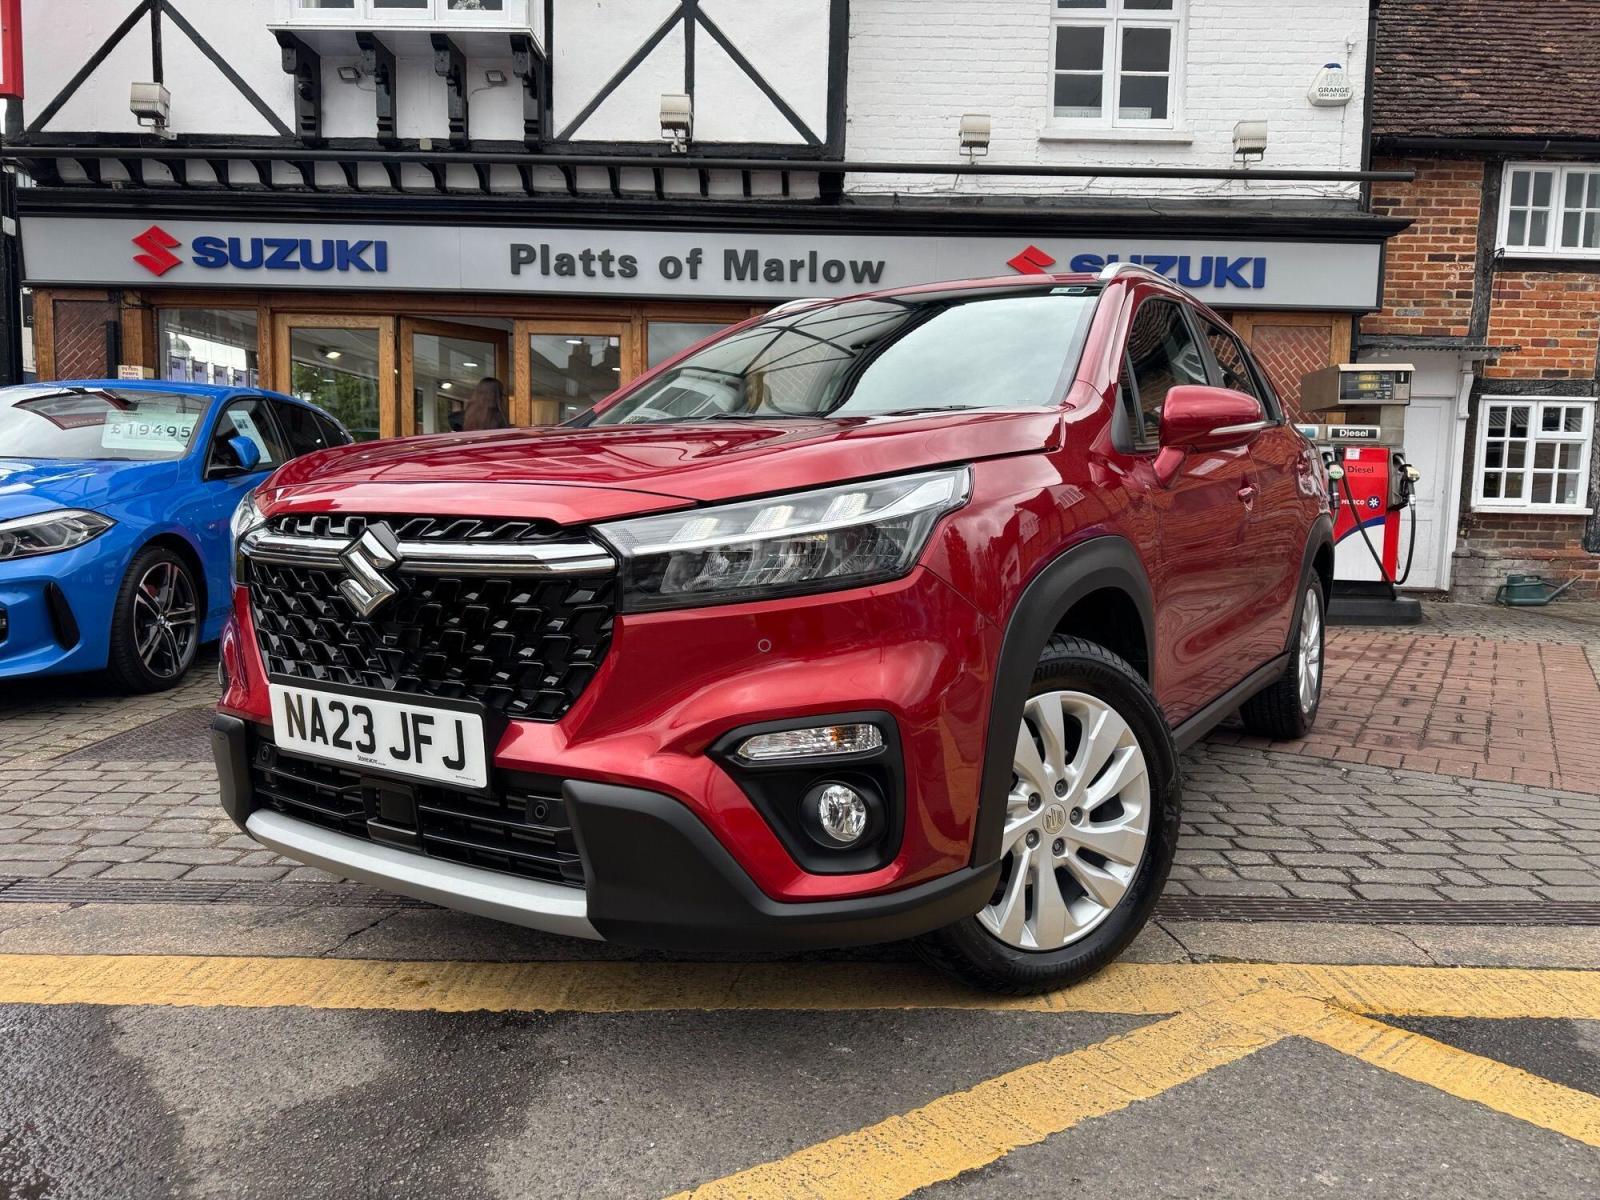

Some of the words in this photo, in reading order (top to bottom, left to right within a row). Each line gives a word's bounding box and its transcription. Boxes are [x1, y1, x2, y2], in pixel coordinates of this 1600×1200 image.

[191, 236, 388, 273] SUZUKI
[510, 243, 638, 278] Platts
[658, 248, 703, 280] of
[723, 249, 885, 283] Marlow
[111, 423, 191, 439] £19495
[1339, 429, 1369, 437] Diesel
[1347, 465, 1374, 474] Diesel
[283, 692, 377, 754] NA23
[389, 711, 467, 771] JFJ
